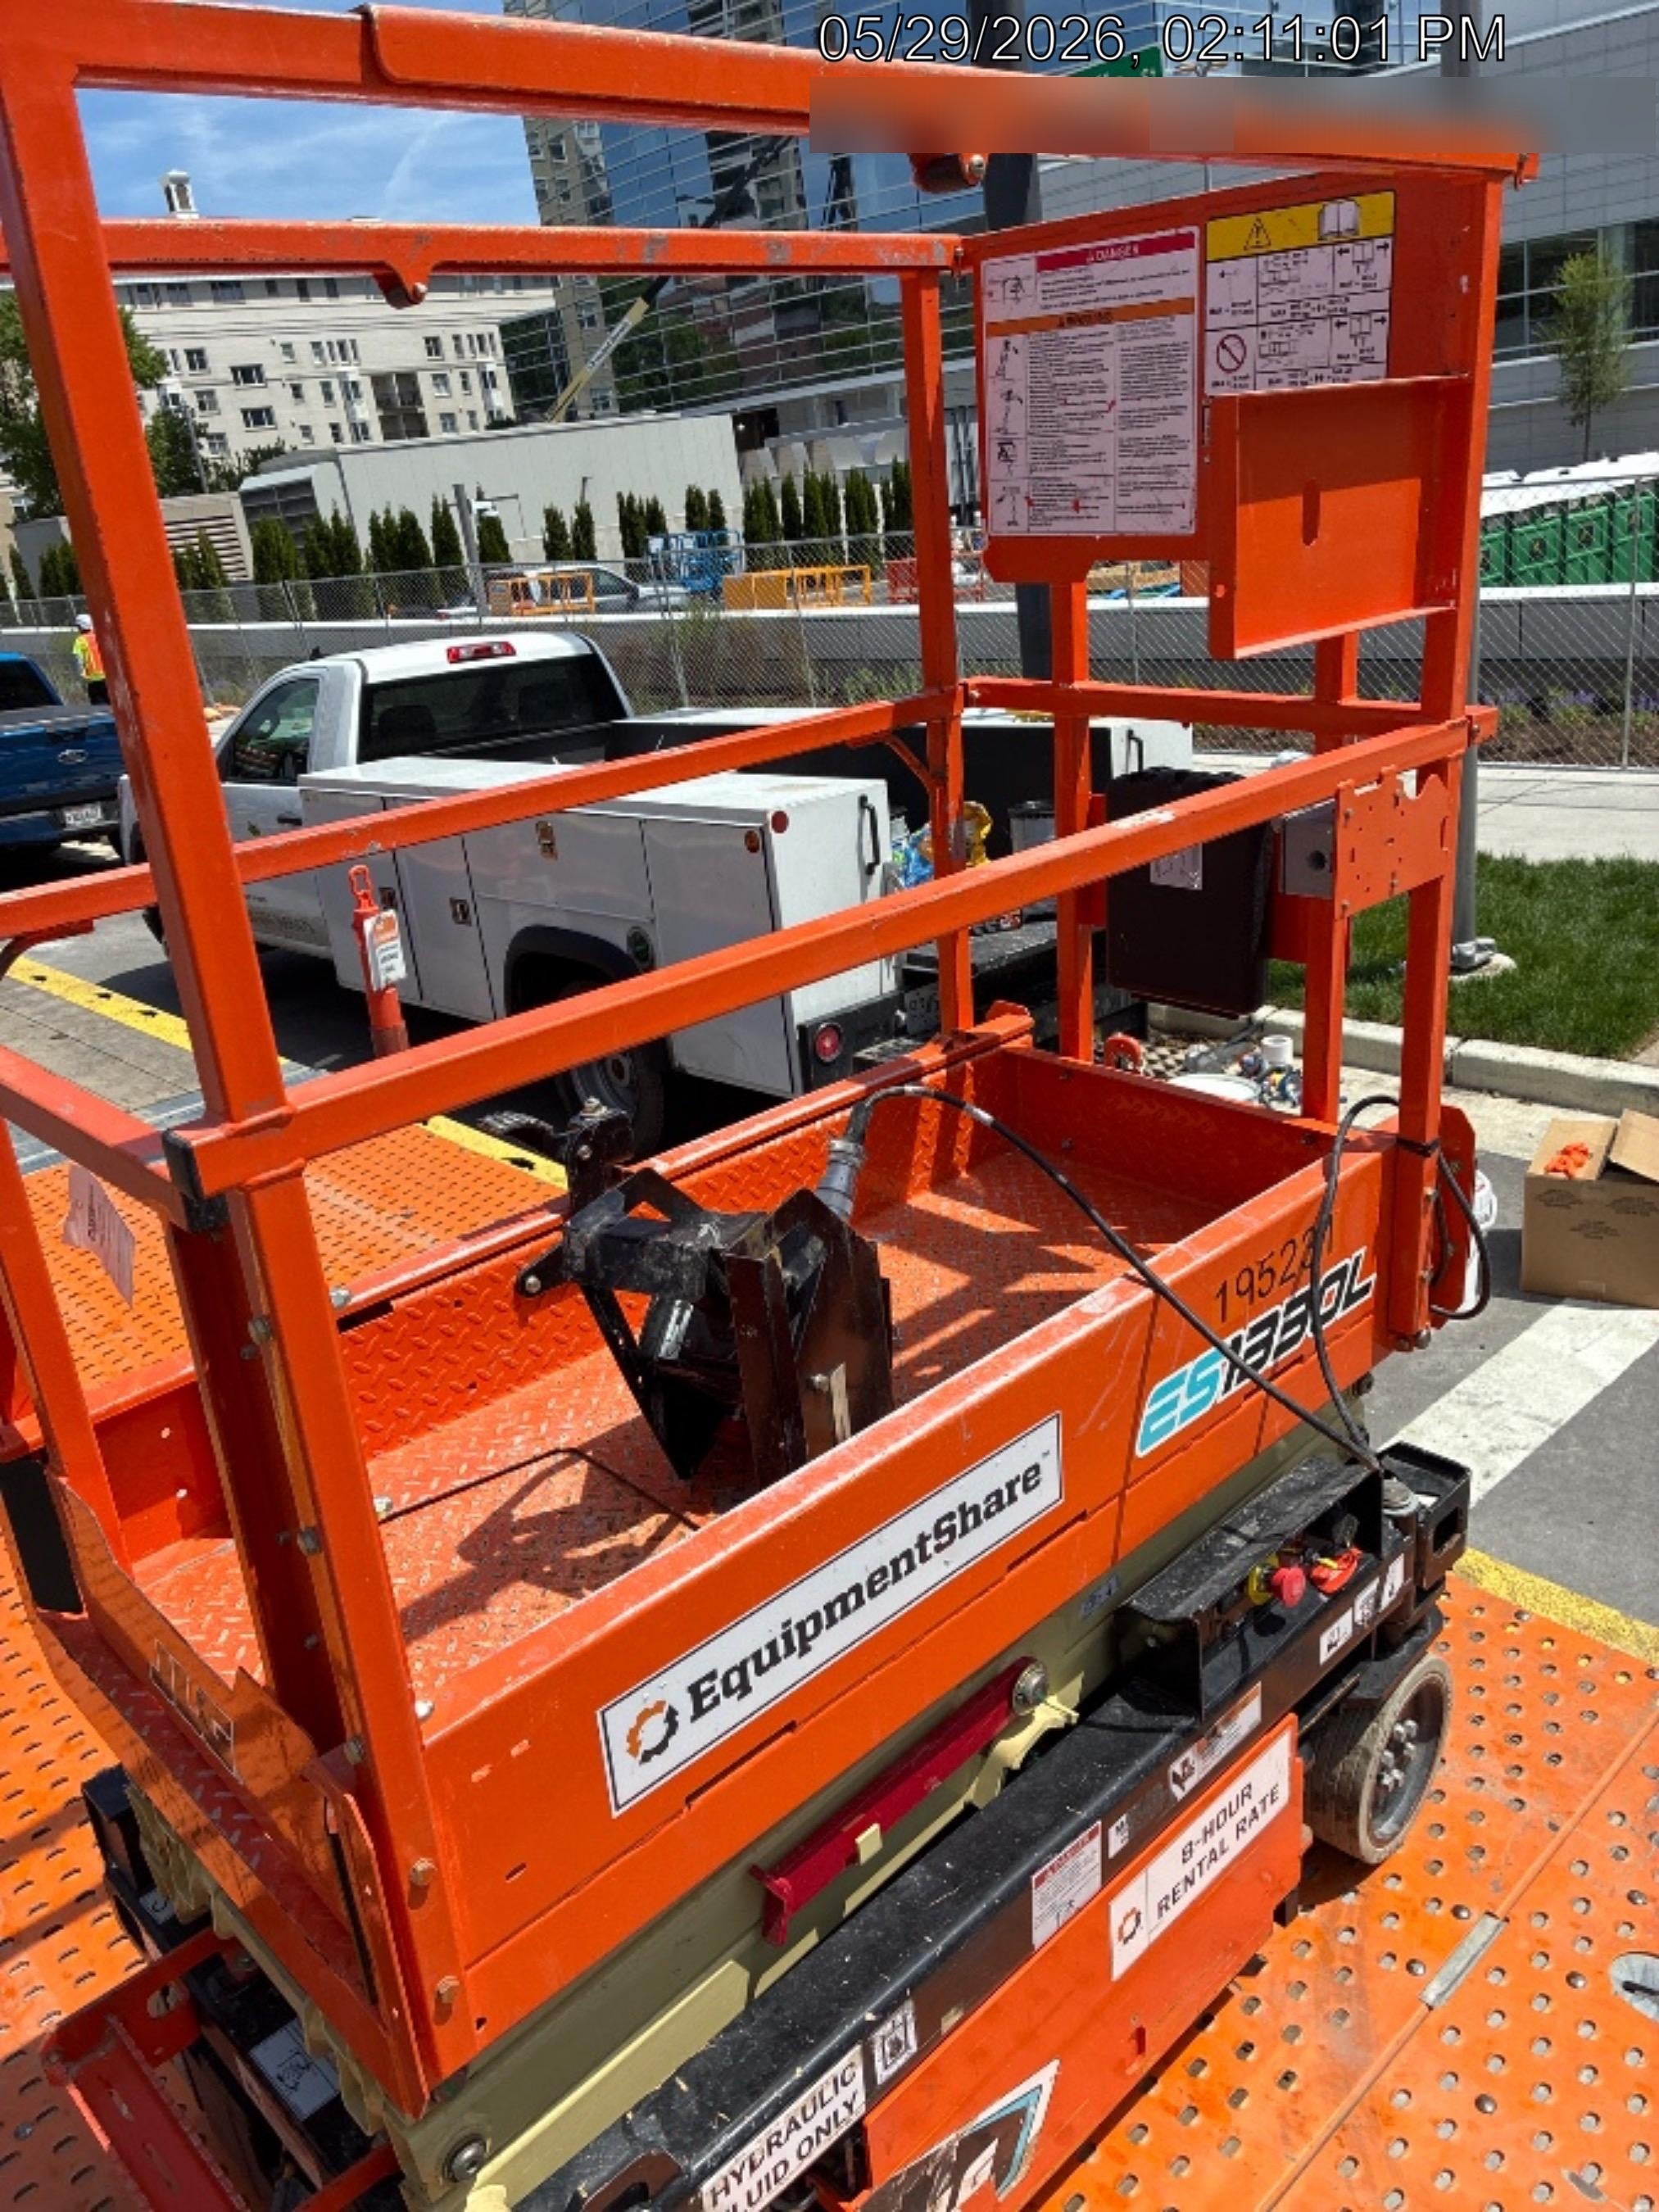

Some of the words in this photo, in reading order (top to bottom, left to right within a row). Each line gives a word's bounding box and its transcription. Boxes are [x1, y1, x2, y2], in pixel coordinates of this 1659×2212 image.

[686, 1459, 1043, 1722] EquipmentShare
[1157, 1838, 1229, 1920] RENTAL
[1235, 1784, 1279, 1840] RATE
[1181, 1782, 1253, 1865] 8-HOUR
[710, 2061, 856, 2208] HYDRAULIC
[796, 2090, 858, 2161] ONLY
